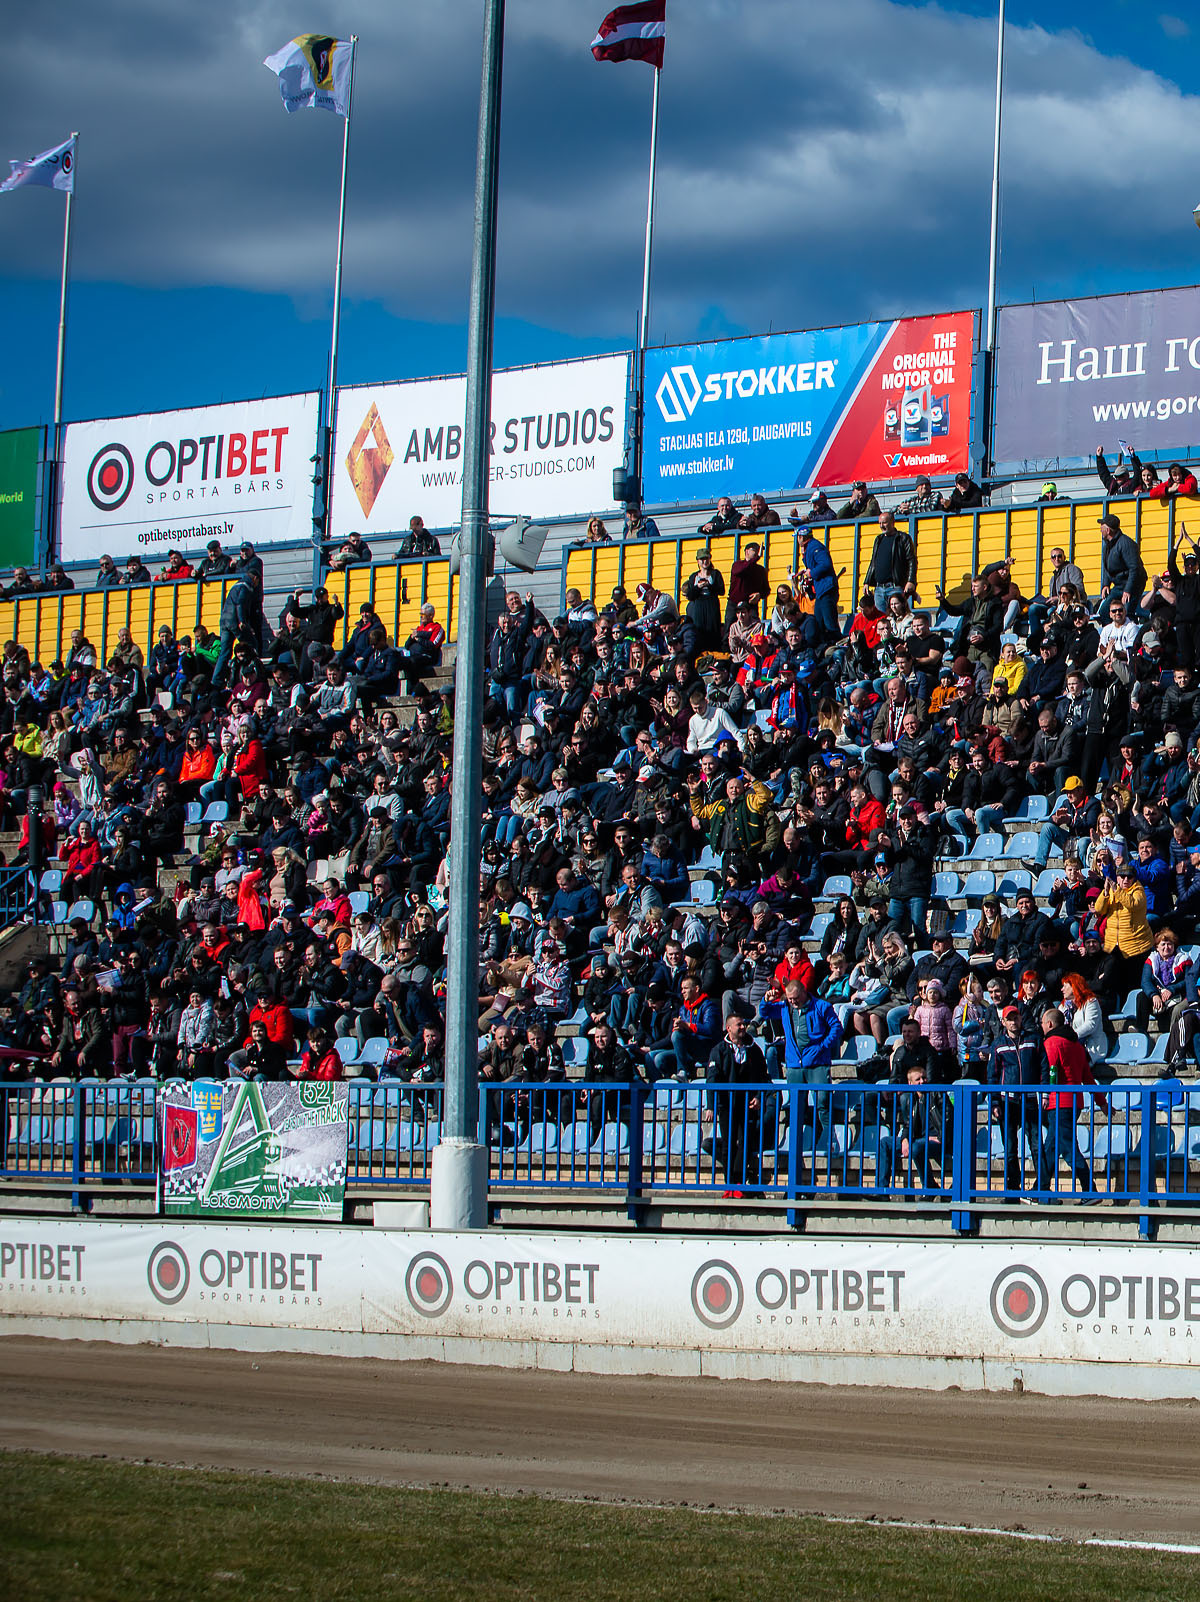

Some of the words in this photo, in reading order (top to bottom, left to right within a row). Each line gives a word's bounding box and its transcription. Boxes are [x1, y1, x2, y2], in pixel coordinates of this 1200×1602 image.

[932, 332, 957, 350] THE
[892, 350, 956, 371] ORIGINAL
[1036, 339, 1147, 385] Наш
[702, 360, 836, 403] STOKKER
[882, 369, 930, 390] MOTOR
[932, 367, 955, 384] OIL
[403, 422, 496, 464] AMBR
[503, 406, 614, 454] STUDIOS
[659, 432, 703, 452] STACIJAS
[705, 431, 725, 447] IELA
[752, 420, 812, 442] DAUGAVPILS
[145, 426, 289, 487] OPTIBET
[659, 454, 735, 478] www.stokker.lv
[147, 486, 220, 504] SPORTA
[234, 479, 284, 495] BĀRS
[138, 521, 234, 545] optibetsportabars.lv
[303, 1081, 331, 1104] 52
[316, 1099, 347, 1127] TRACK
[201, 1194, 284, 1210] LOKOMOTIV
[199, 1249, 323, 1293] OPTIBET
[463, 1260, 600, 1304] OPTIBET
[199, 1291, 267, 1304] SPORTA
[279, 1293, 323, 1306] BĀRS
[756, 1268, 906, 1312] OPTIBET
[465, 1305, 539, 1317] SPORTA
[552, 1306, 601, 1319] BĀRS
[756, 1314, 838, 1326] SPORTA
[853, 1315, 906, 1328] BĀRS
[1062, 1322, 1153, 1336] SPORTA
